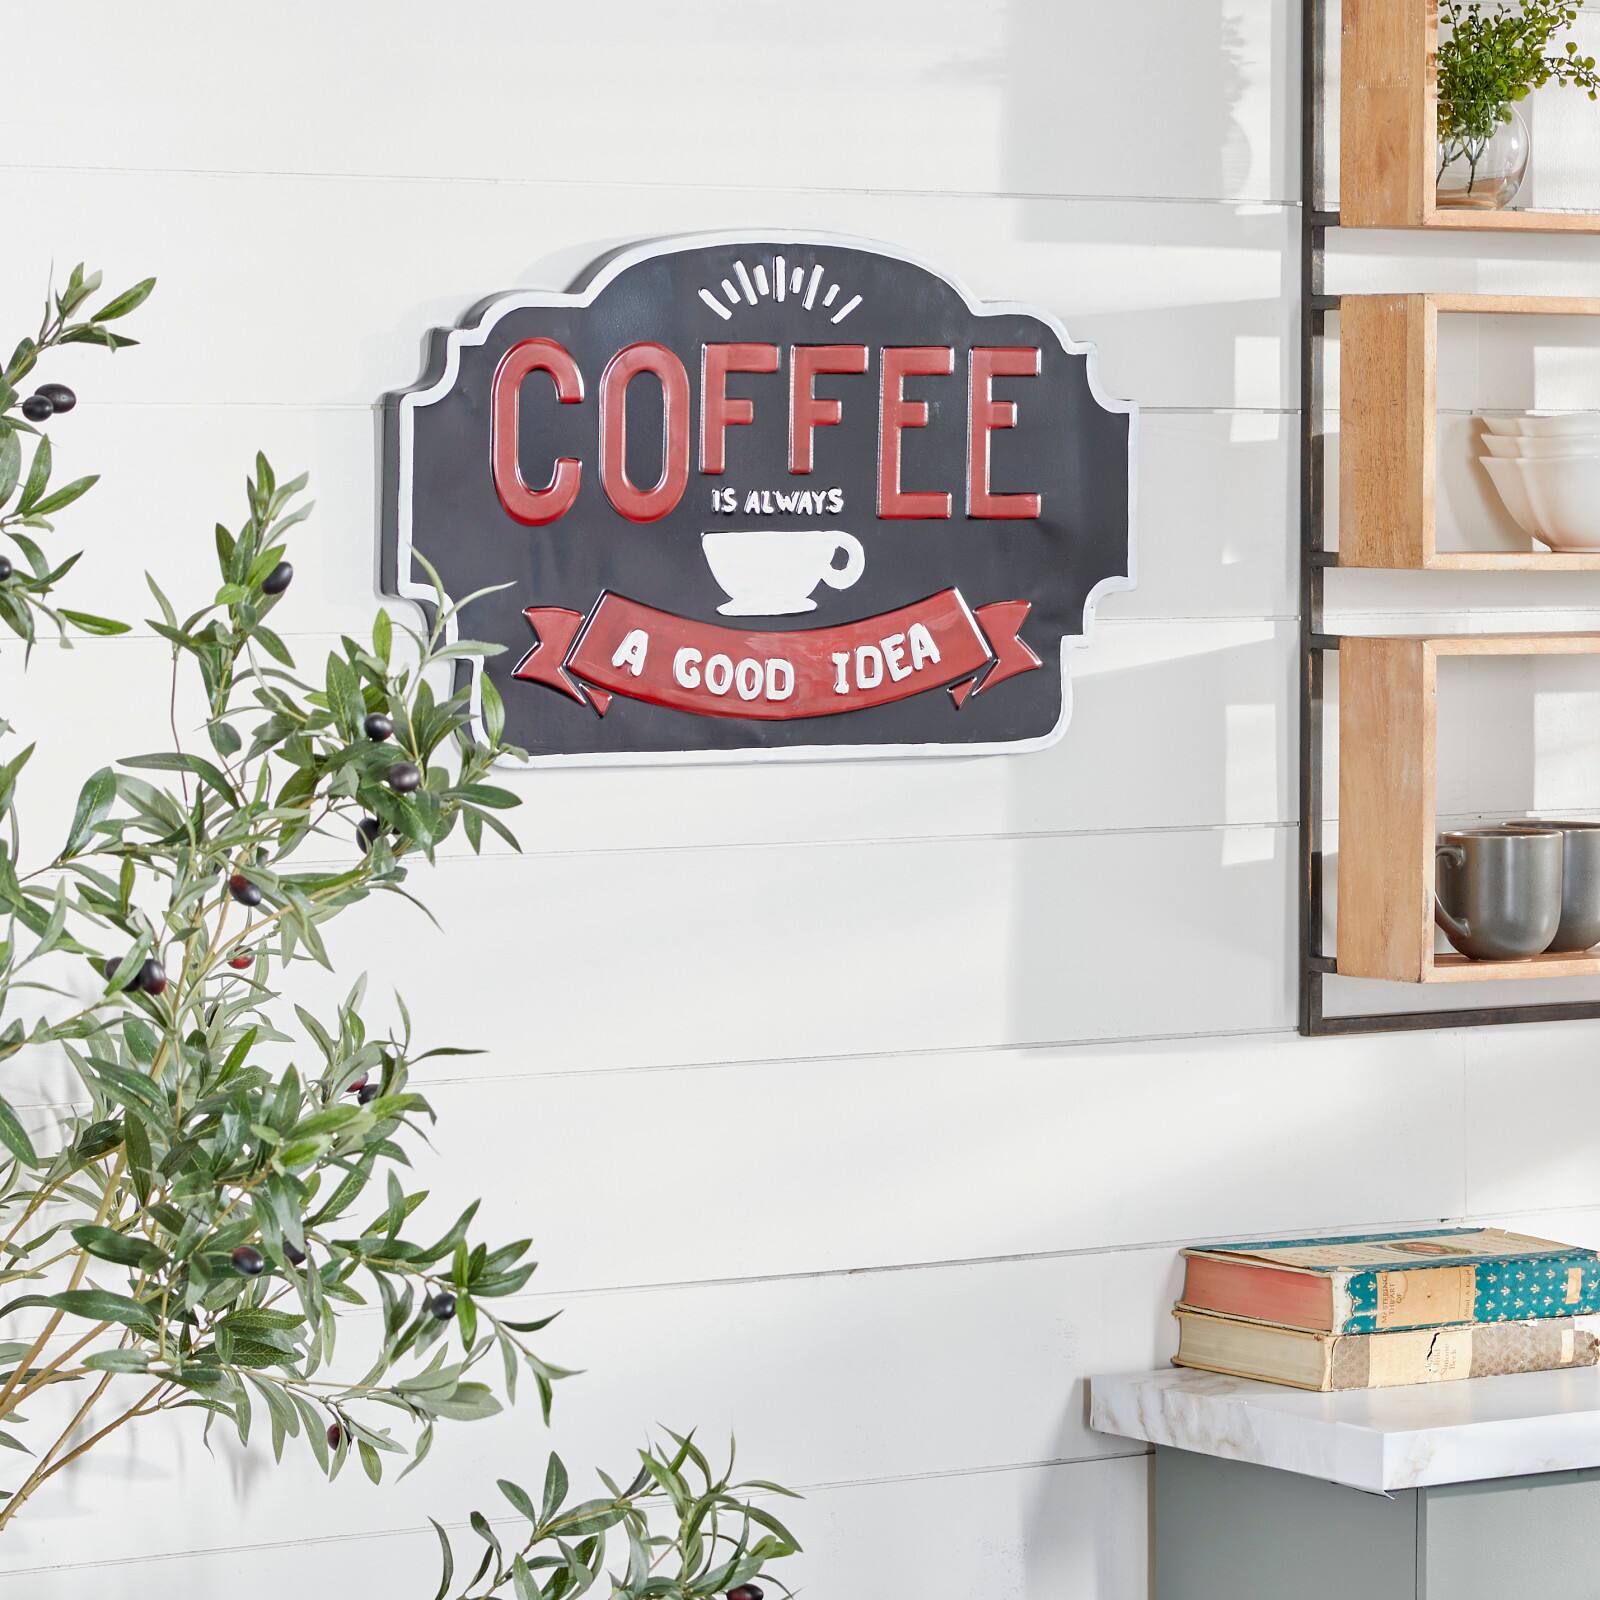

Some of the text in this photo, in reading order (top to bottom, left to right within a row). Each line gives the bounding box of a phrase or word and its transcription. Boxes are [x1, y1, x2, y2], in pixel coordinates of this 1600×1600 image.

[490, 337, 1042, 525] COFFEE
[711, 487, 844, 515] IS ALWAYS
[611, 622, 942, 701] A GOOD IDEA
